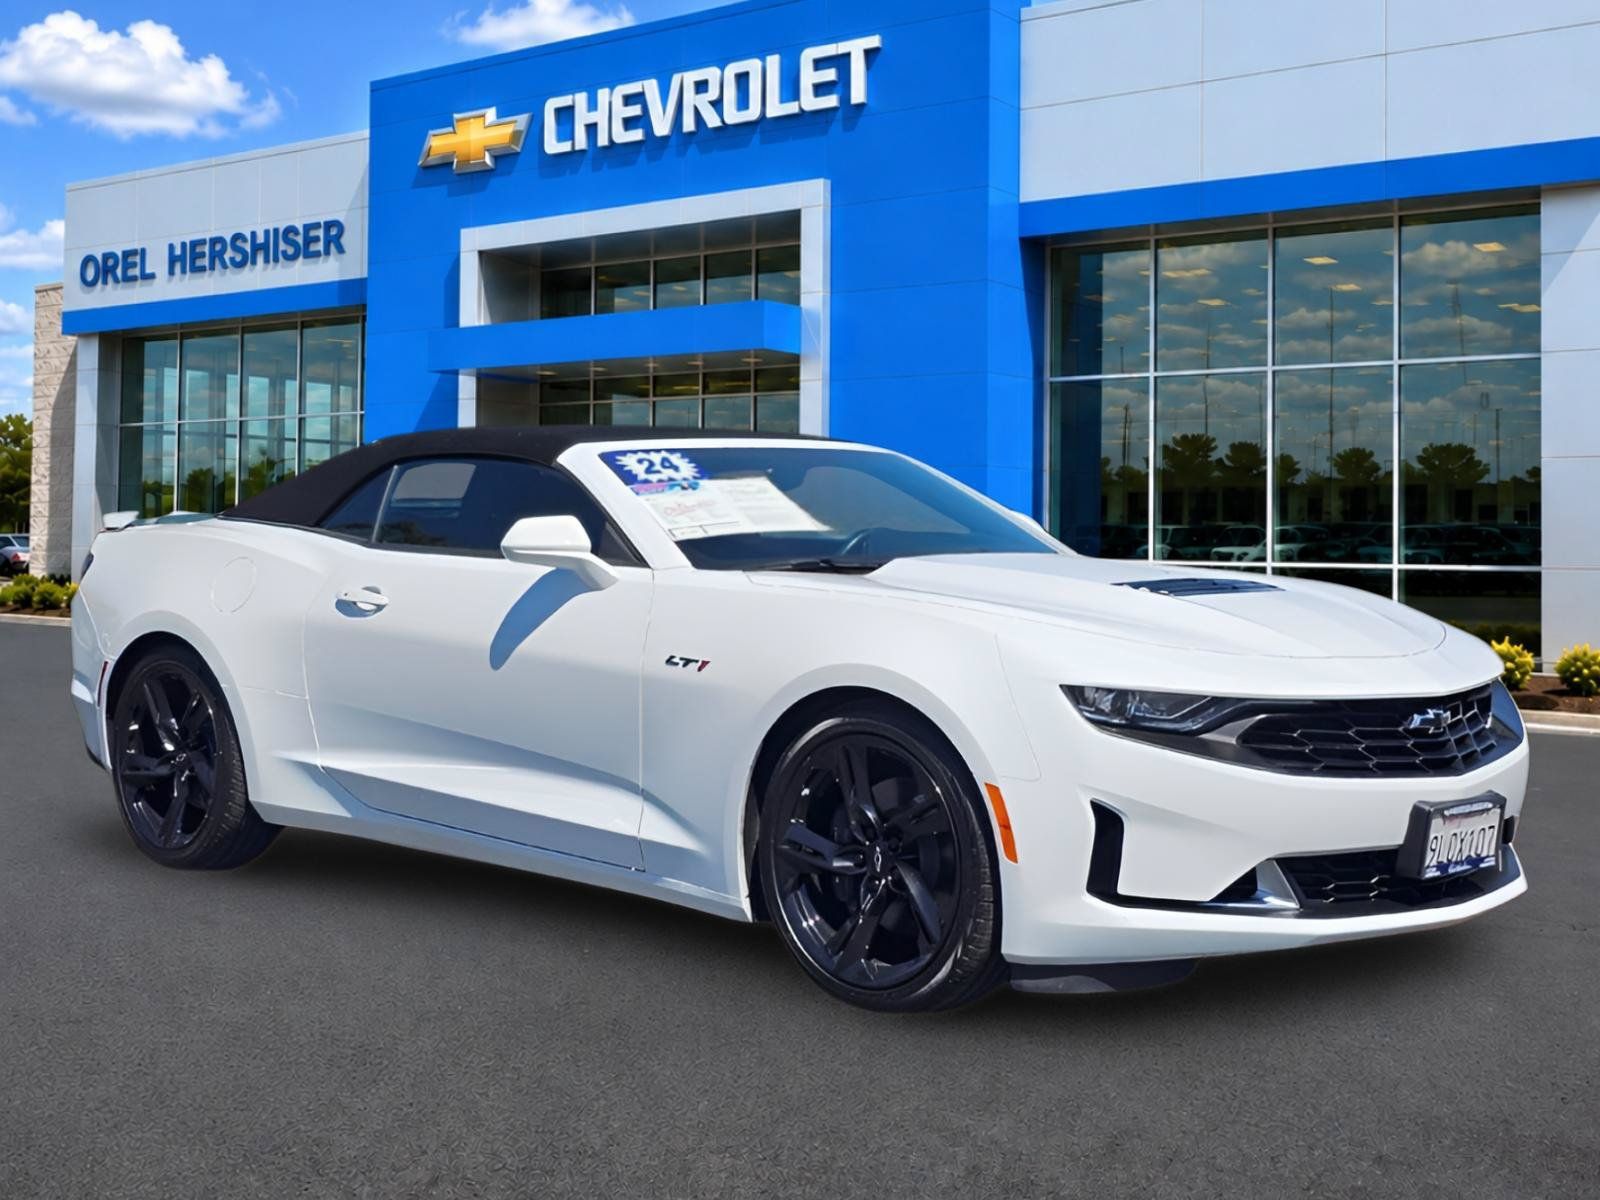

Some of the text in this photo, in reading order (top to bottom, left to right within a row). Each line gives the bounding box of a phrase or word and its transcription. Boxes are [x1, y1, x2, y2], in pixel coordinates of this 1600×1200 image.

[543, 35, 882, 154] CHEVROLET
[80, 219, 345, 287] OREL HERSHISER
[636, 456, 680, 474] 24
[665, 655, 711, 672] LT1
